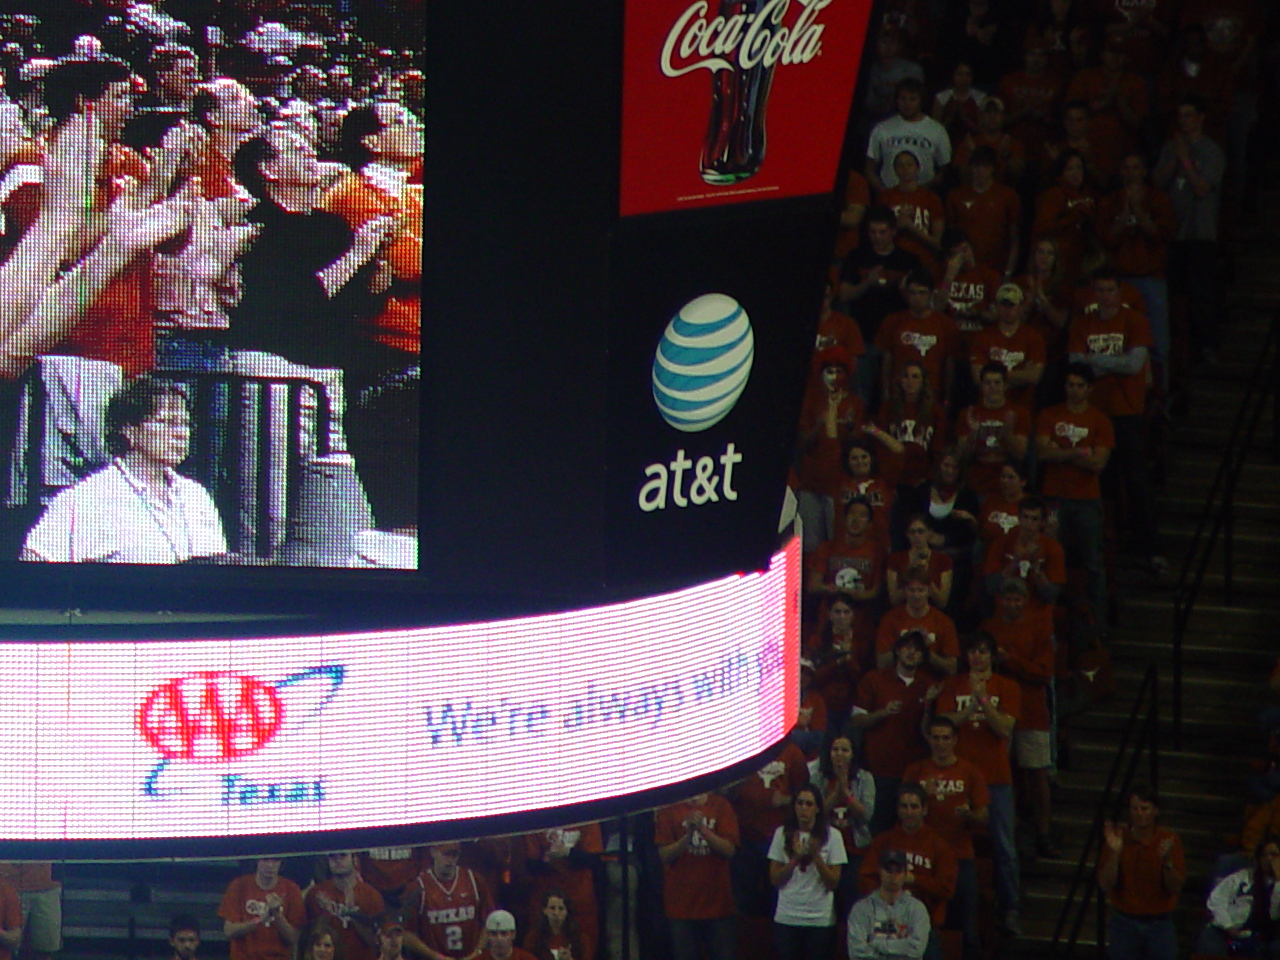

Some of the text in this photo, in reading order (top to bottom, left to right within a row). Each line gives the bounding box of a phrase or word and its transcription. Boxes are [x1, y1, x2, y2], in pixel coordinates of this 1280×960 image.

[950, 281, 984, 300] EXAS
[639, 442, 742, 513] at&t
[425, 696, 548, 748] We're
[563, 679, 684, 730] always
[427, 904, 476, 924] TEXAS
[444, 926, 464, 951] 2
